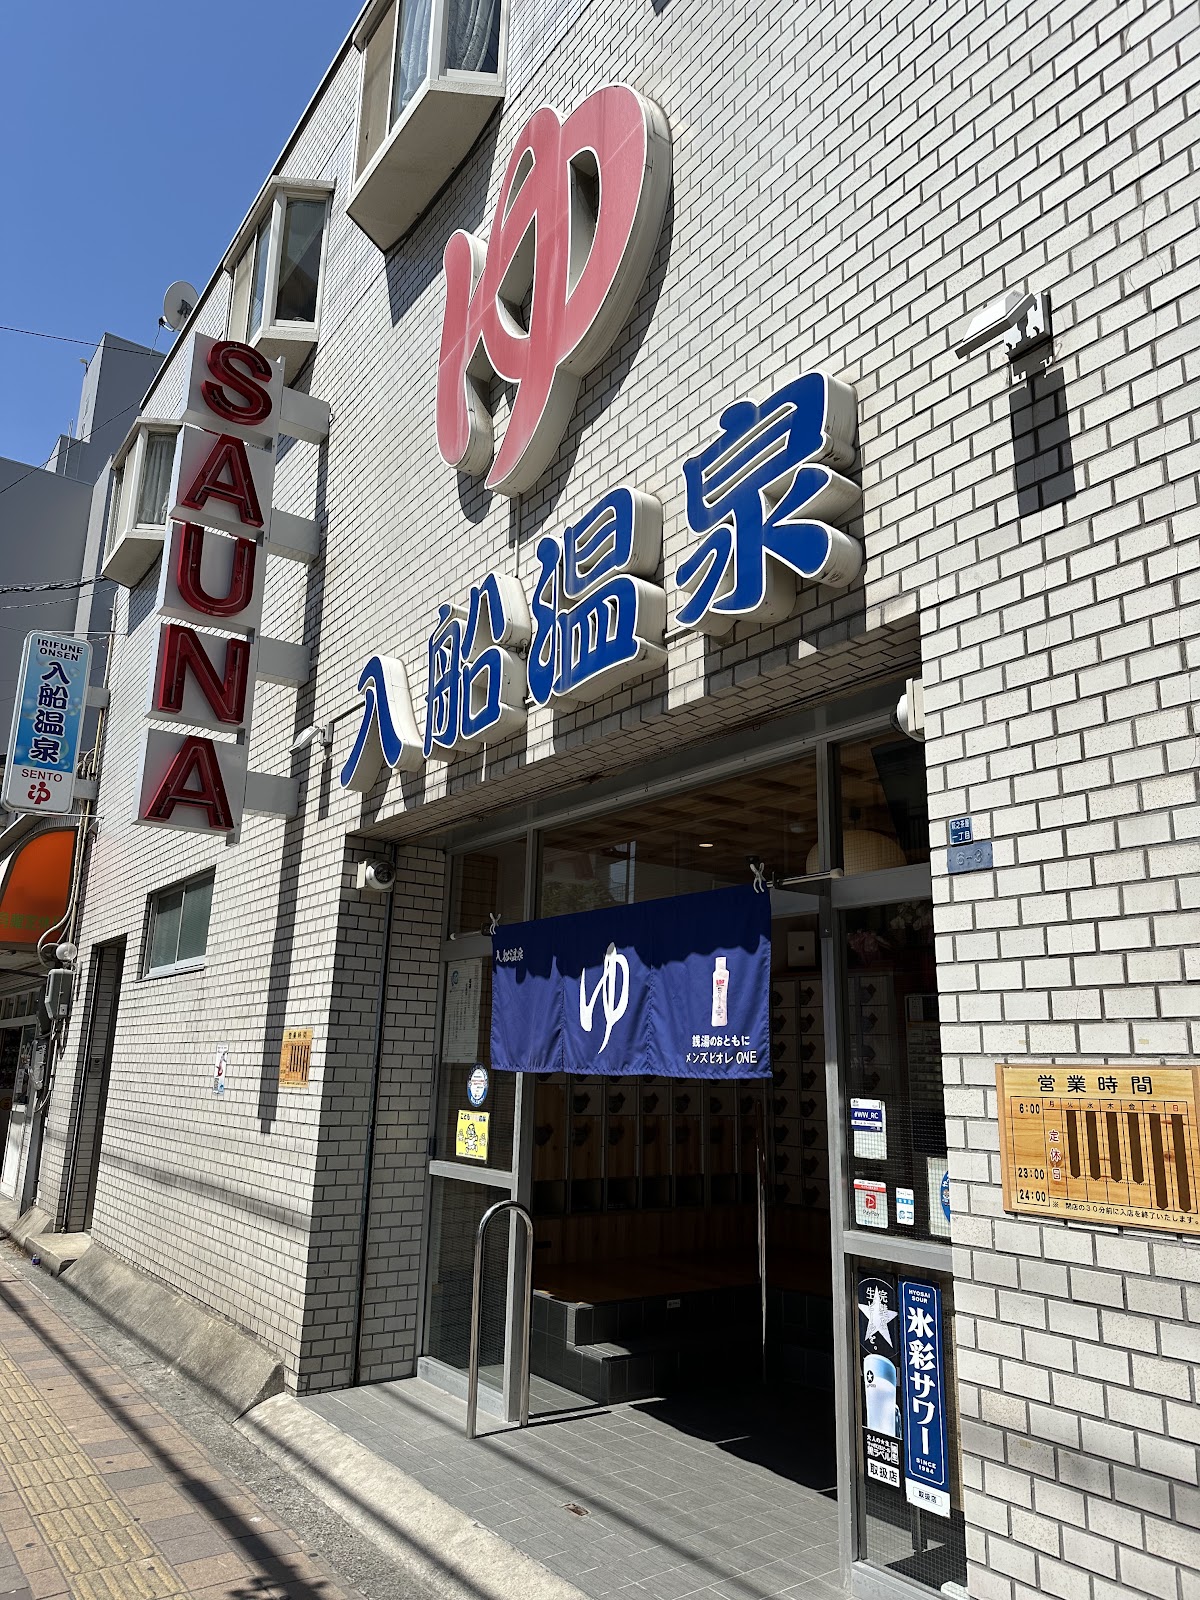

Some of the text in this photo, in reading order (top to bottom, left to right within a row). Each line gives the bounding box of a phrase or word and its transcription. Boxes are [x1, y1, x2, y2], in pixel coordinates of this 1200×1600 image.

[436, 82, 664, 492] ゆ
[144, 339, 274, 832] SAUNA
[340, 370, 850, 791] 入船温泉
[36, 638, 84, 655] IRIFUNE
[39, 648, 80, 662] ONSEN
[30, 661, 71, 763] 入船温泉
[21, 768, 63, 782] SENTO
[579, 941, 630, 1055] ゆ
[692, 1034, 750, 1048] 銭湯のおともに
[686, 1050, 758, 1064] メンズビオレ ONE
[1037, 1074, 1153, 1095] 営業時間
[1019, 1103, 1041, 1115] 6:00
[1048, 1129, 1061, 1181] 定休日
[1018, 1167, 1045, 1180] 23:00
[1019, 1189, 1046, 1202] 24:00
[908, 1289, 931, 1299] HYOSAI
[911, 1295, 928, 1304] SOUR
[907, 1306, 936, 1455] 氷彩サワー
[915, 1457, 937, 1469] SINCE
[869, 1462, 898, 1484] 取扱店
